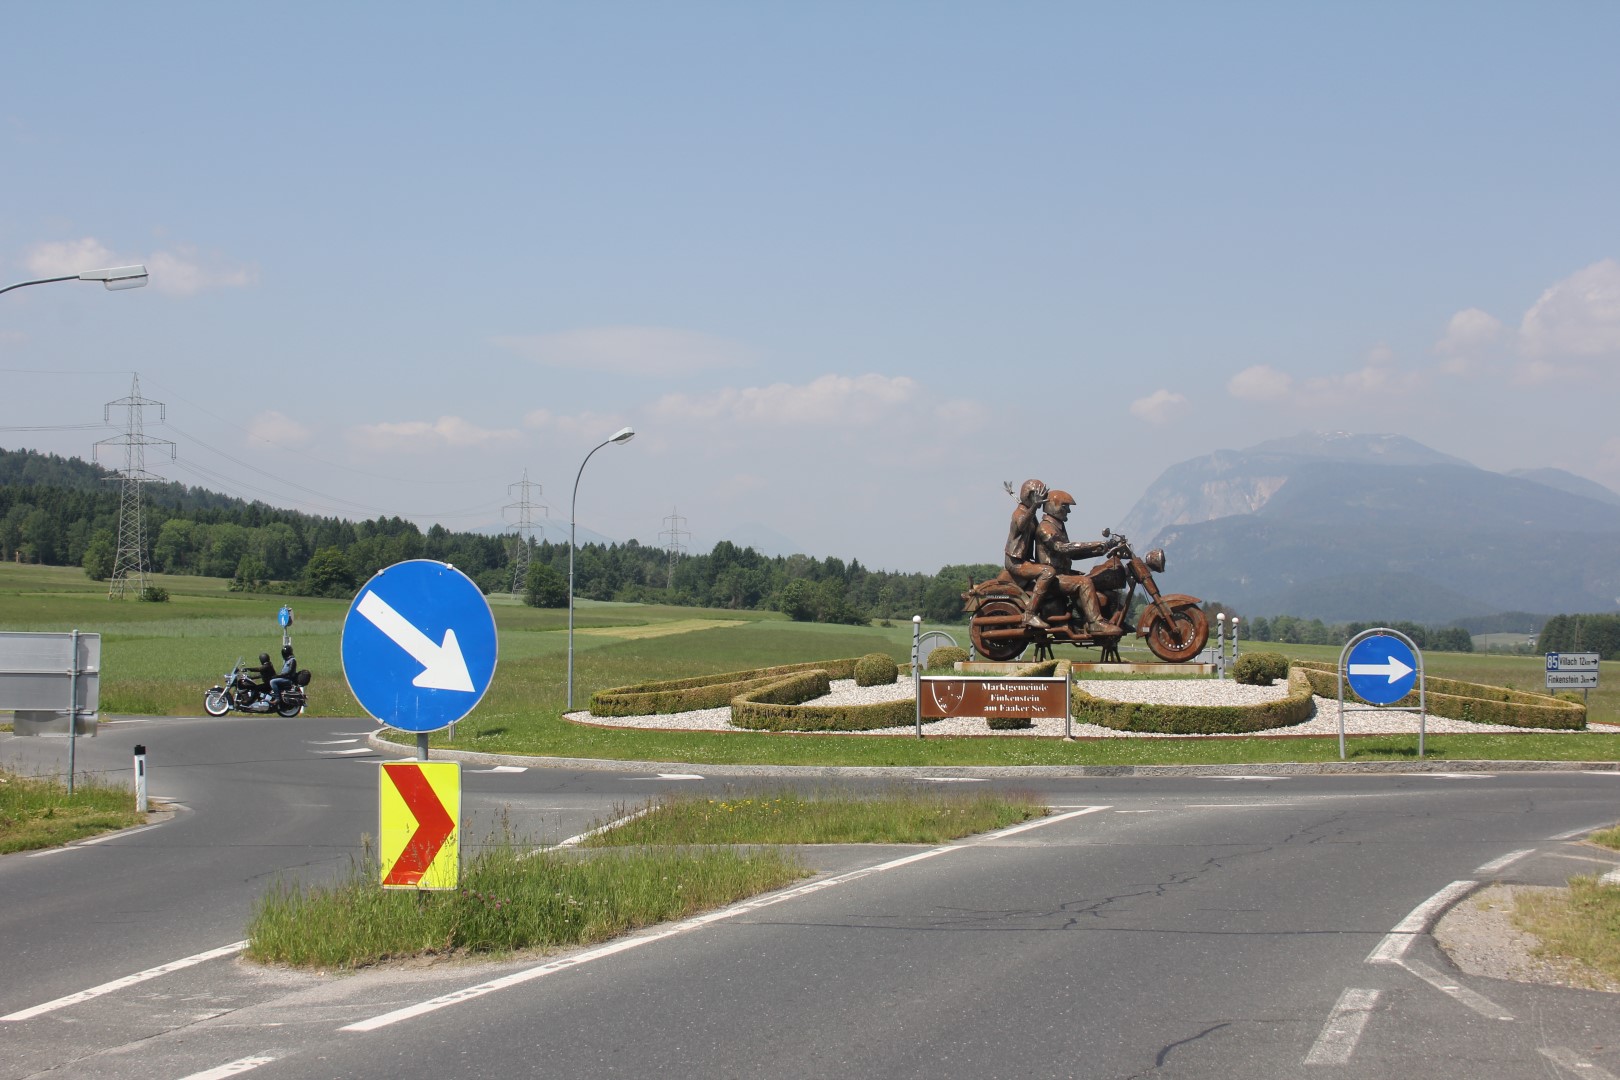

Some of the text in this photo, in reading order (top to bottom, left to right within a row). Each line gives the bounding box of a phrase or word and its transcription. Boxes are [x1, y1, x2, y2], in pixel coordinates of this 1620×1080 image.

[1547, 655, 1558, 668] 85
[1559, 657, 1577, 666] Villach
[1548, 675, 1578, 683] Finkenstein
[982, 683, 1049, 692] Marktgemeinde
